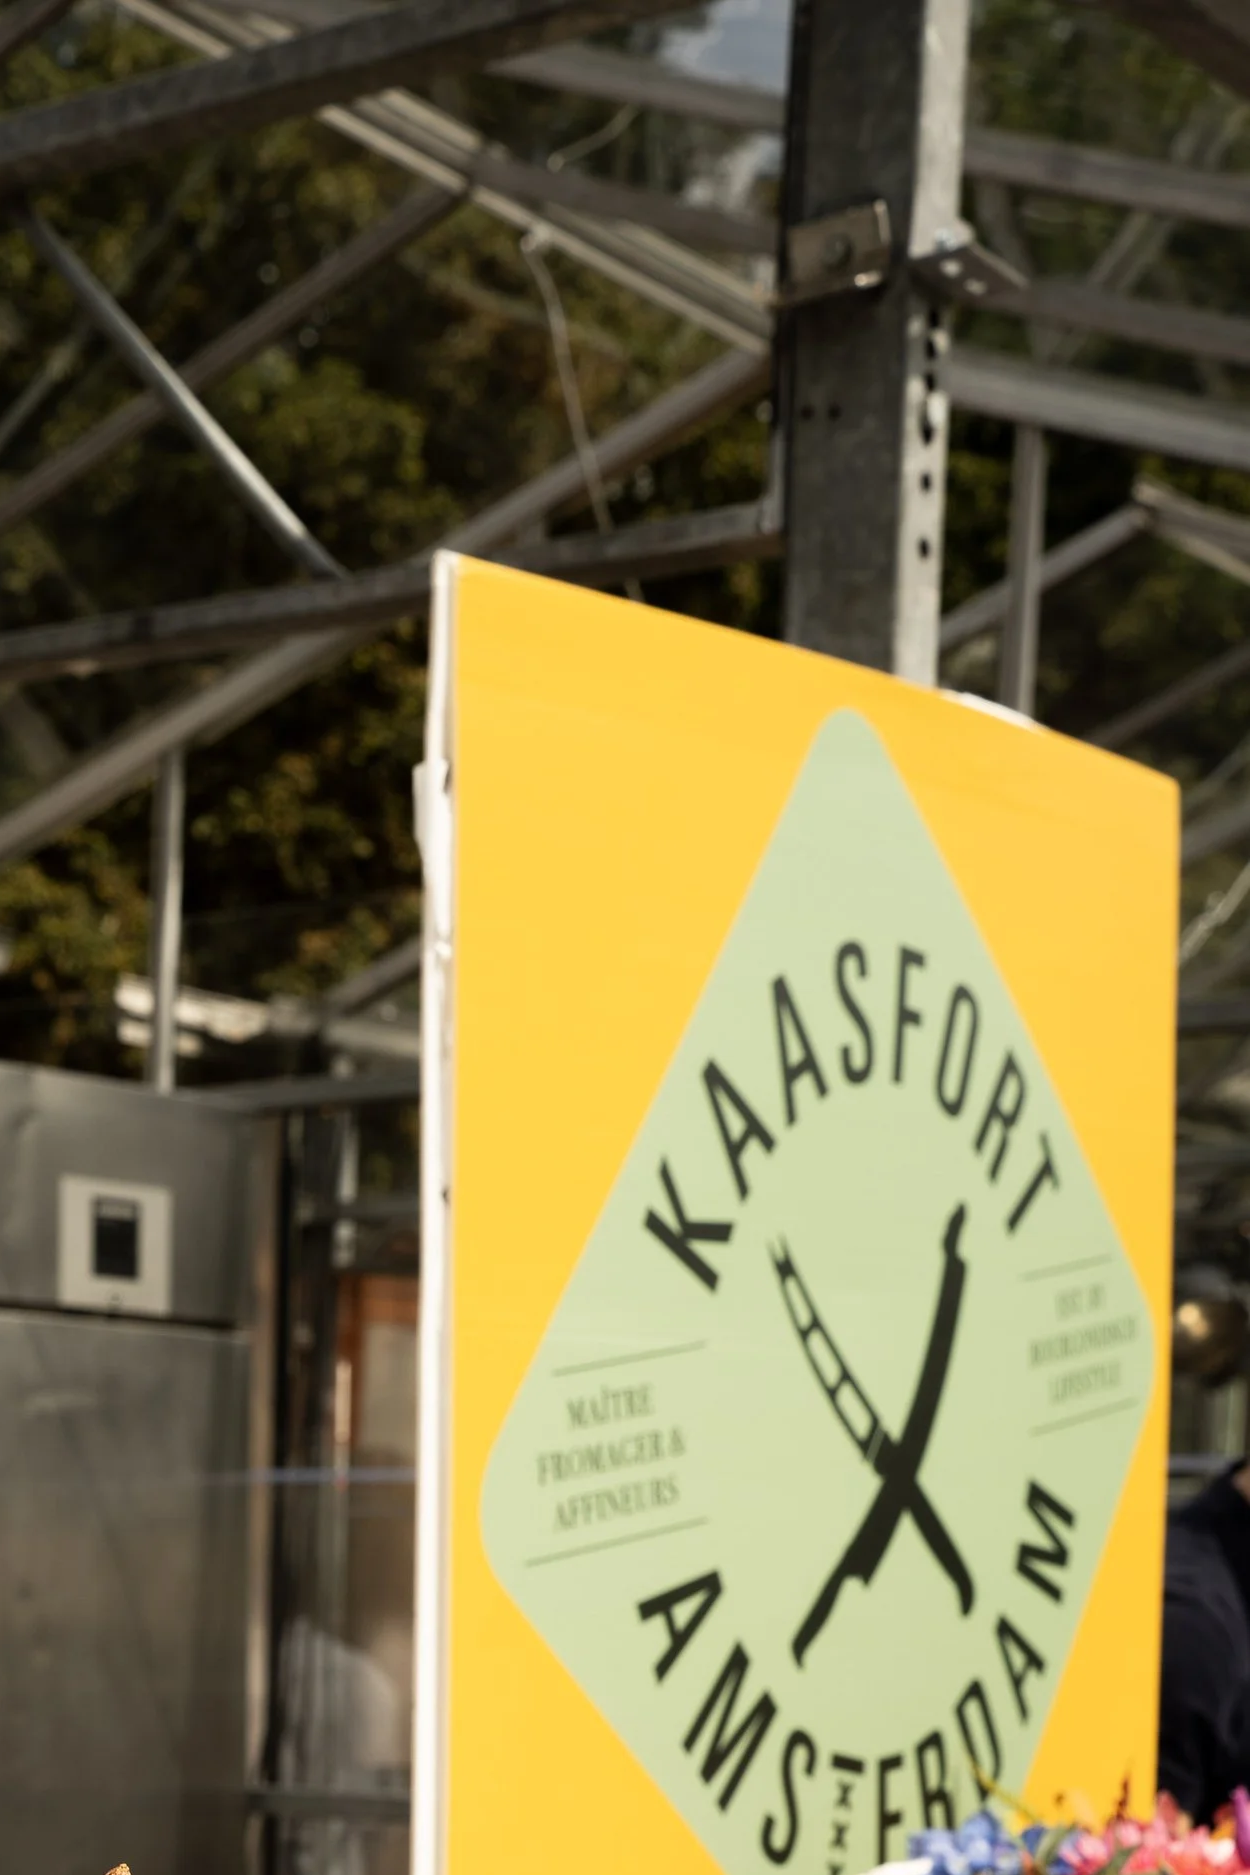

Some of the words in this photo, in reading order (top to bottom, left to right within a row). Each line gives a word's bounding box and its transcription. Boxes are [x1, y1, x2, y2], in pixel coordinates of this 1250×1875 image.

[643, 940, 1061, 1293] KAASFORT
[536, 1429, 664, 1486] FROMAGER
[553, 1473, 681, 1533] AFFINEURS
